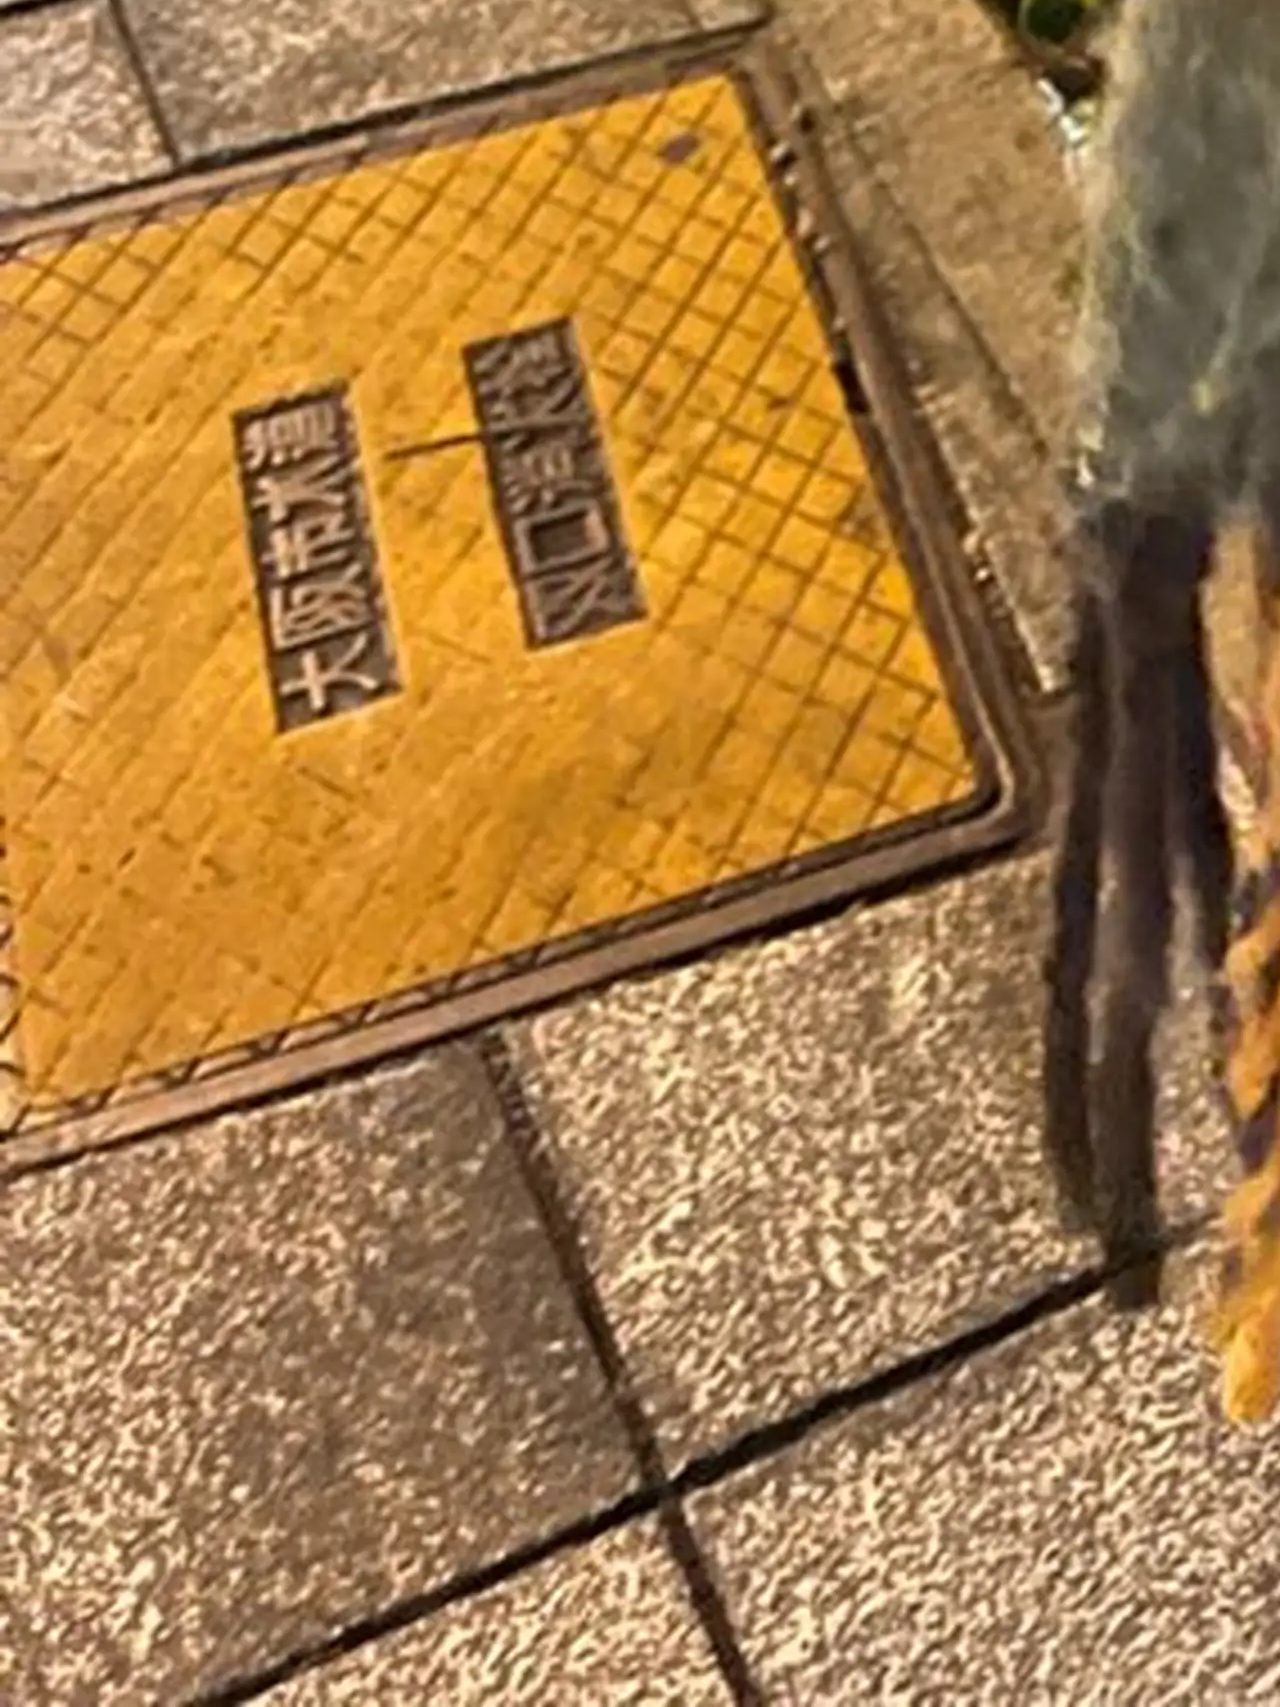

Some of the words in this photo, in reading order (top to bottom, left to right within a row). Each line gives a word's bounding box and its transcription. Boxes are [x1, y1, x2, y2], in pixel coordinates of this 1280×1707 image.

[242, 399, 382, 711] 大阪市水道
